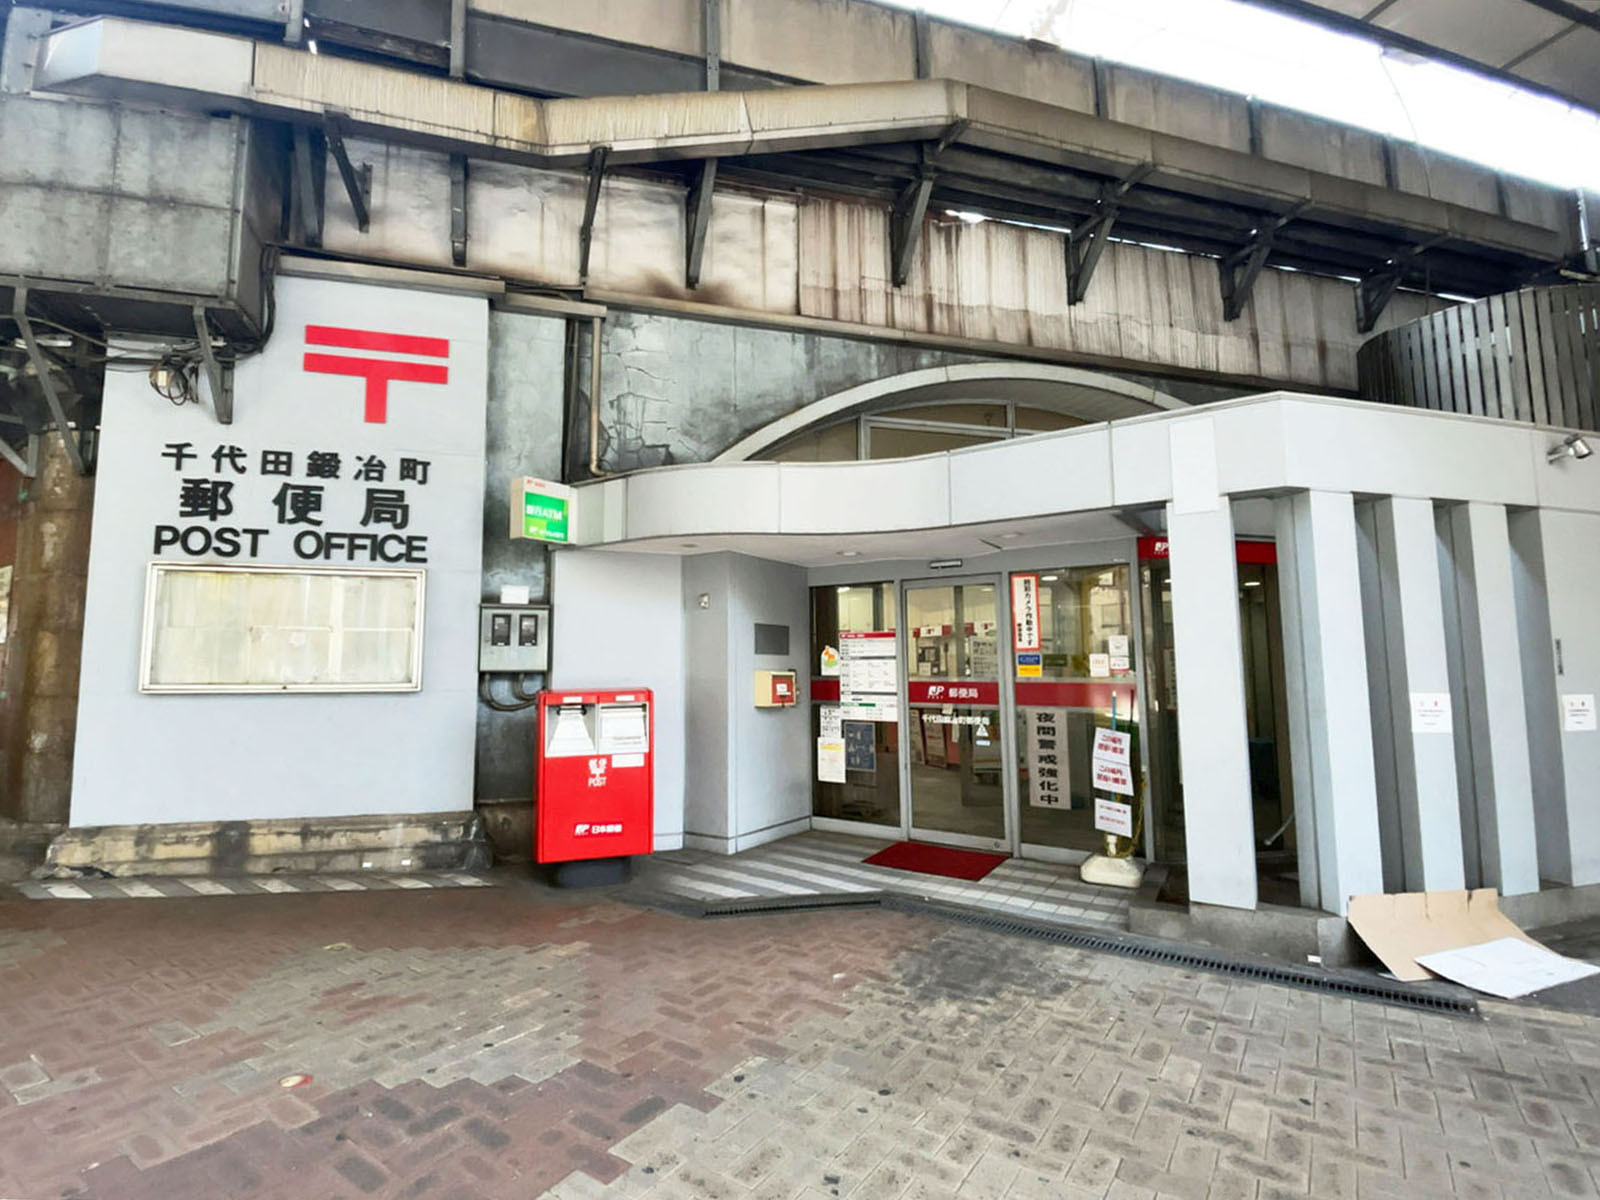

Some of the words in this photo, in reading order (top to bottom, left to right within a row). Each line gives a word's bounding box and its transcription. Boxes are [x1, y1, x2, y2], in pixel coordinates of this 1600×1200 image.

[161, 442, 431, 485] 千代田鍛冶町
[179, 478, 410, 530] 郵便局
[153, 525, 269, 557] POST
[293, 530, 428, 563] OFFICE
[948, 687, 979, 699] 郵便局
[1036, 712, 1059, 805] 夜間警戒強化中
